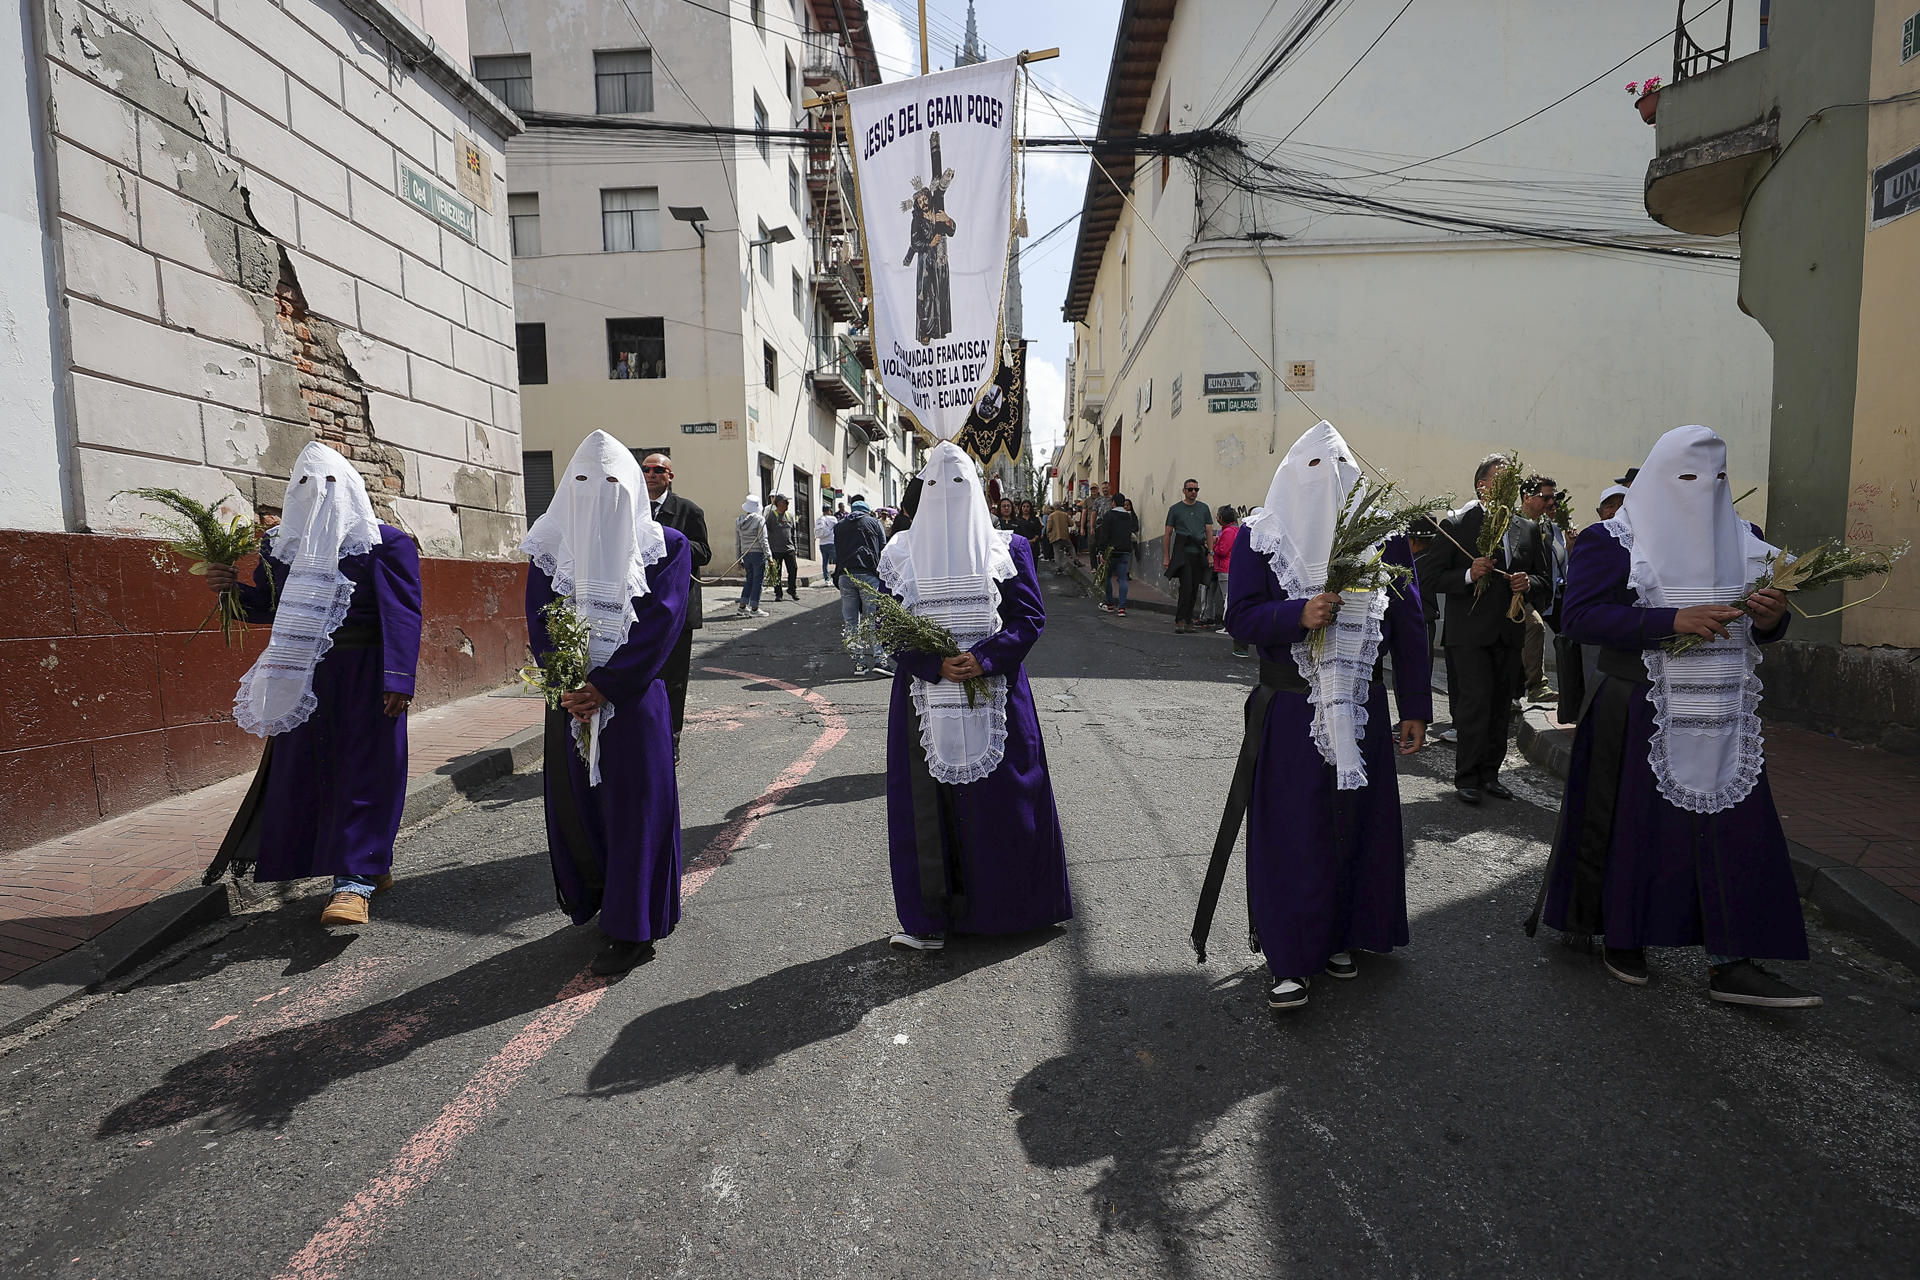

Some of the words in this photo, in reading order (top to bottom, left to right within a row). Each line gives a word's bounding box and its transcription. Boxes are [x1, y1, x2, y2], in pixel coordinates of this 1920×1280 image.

[864, 113, 895, 161] JESUS
[899, 102, 922, 137] DEL
[927, 95, 962, 128] GRAN
[1893, 167, 1920, 199] UN
[435, 193, 472, 233] VENEZUELA
[894, 340, 934, 367] CMUNDAD
[937, 339, 990, 364] FRANCISCA
[883, 359, 934, 389] VOLUTAROS
[936, 368, 947, 386] DE
[949, 366, 960, 385] LA
[962, 357, 987, 383] DEV
[1212, 379, 1227, 387] UNA
[912, 390, 930, 409] UITO
[938, 387, 977, 409] ECUADO
[1230, 400, 1258, 409] GALAPAGO
